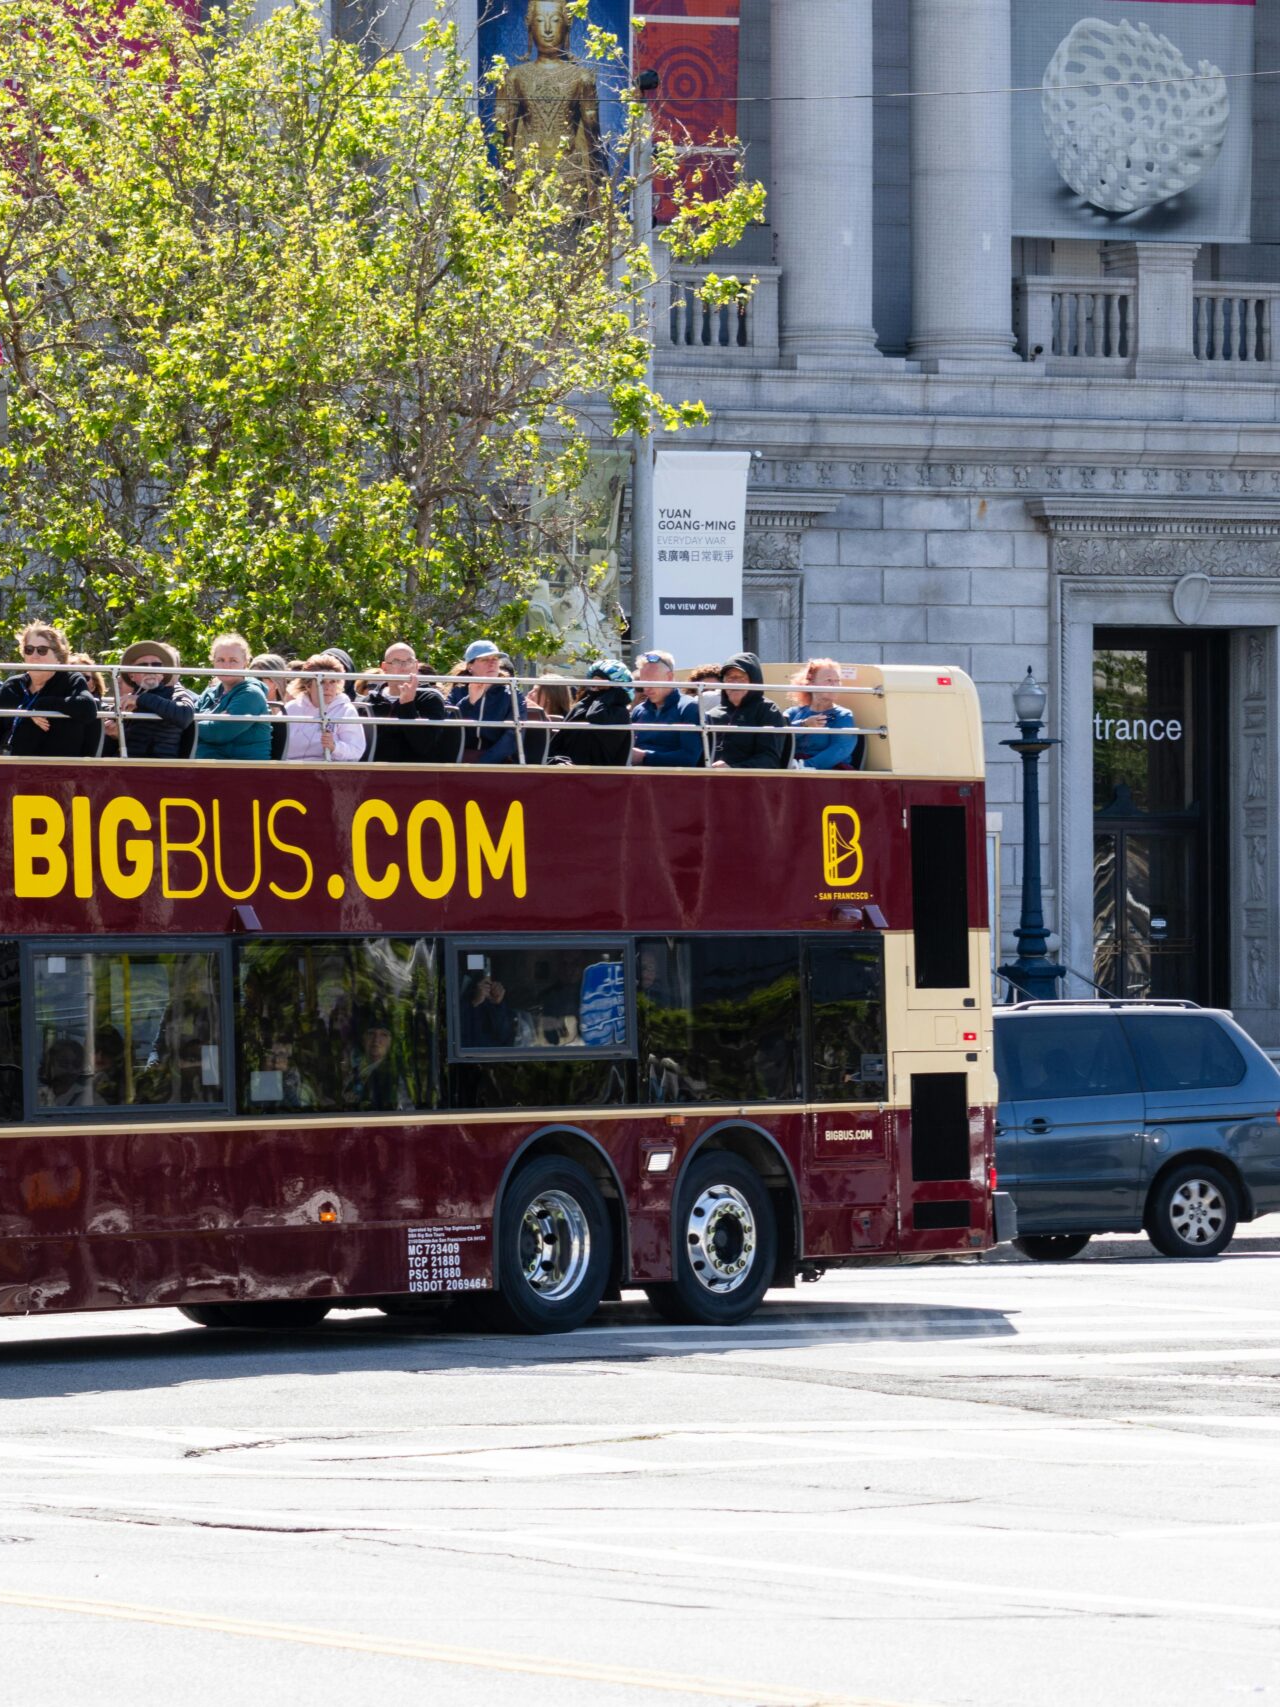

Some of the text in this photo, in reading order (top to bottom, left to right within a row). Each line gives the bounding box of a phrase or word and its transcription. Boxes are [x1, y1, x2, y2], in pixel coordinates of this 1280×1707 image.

[659, 508, 691, 519] YUAN
[658, 520, 736, 531] GOANG-MING
[657, 535, 726, 545] EVERYDAY WAR
[664, 603, 717, 611] ON VIEW NOW
[12, 795, 528, 900] BIGBUS.COM
[818, 892, 869, 900] SAN FRANCISCO
[825, 1129, 873, 1141] BIGBUS.COM
[408, 1243, 460, 1255] MC 723409
[408, 1255, 460, 1268] TCP 21880
[408, 1267, 461, 1280] PSC 21880
[409, 1278, 487, 1292] USDOT 2069464
